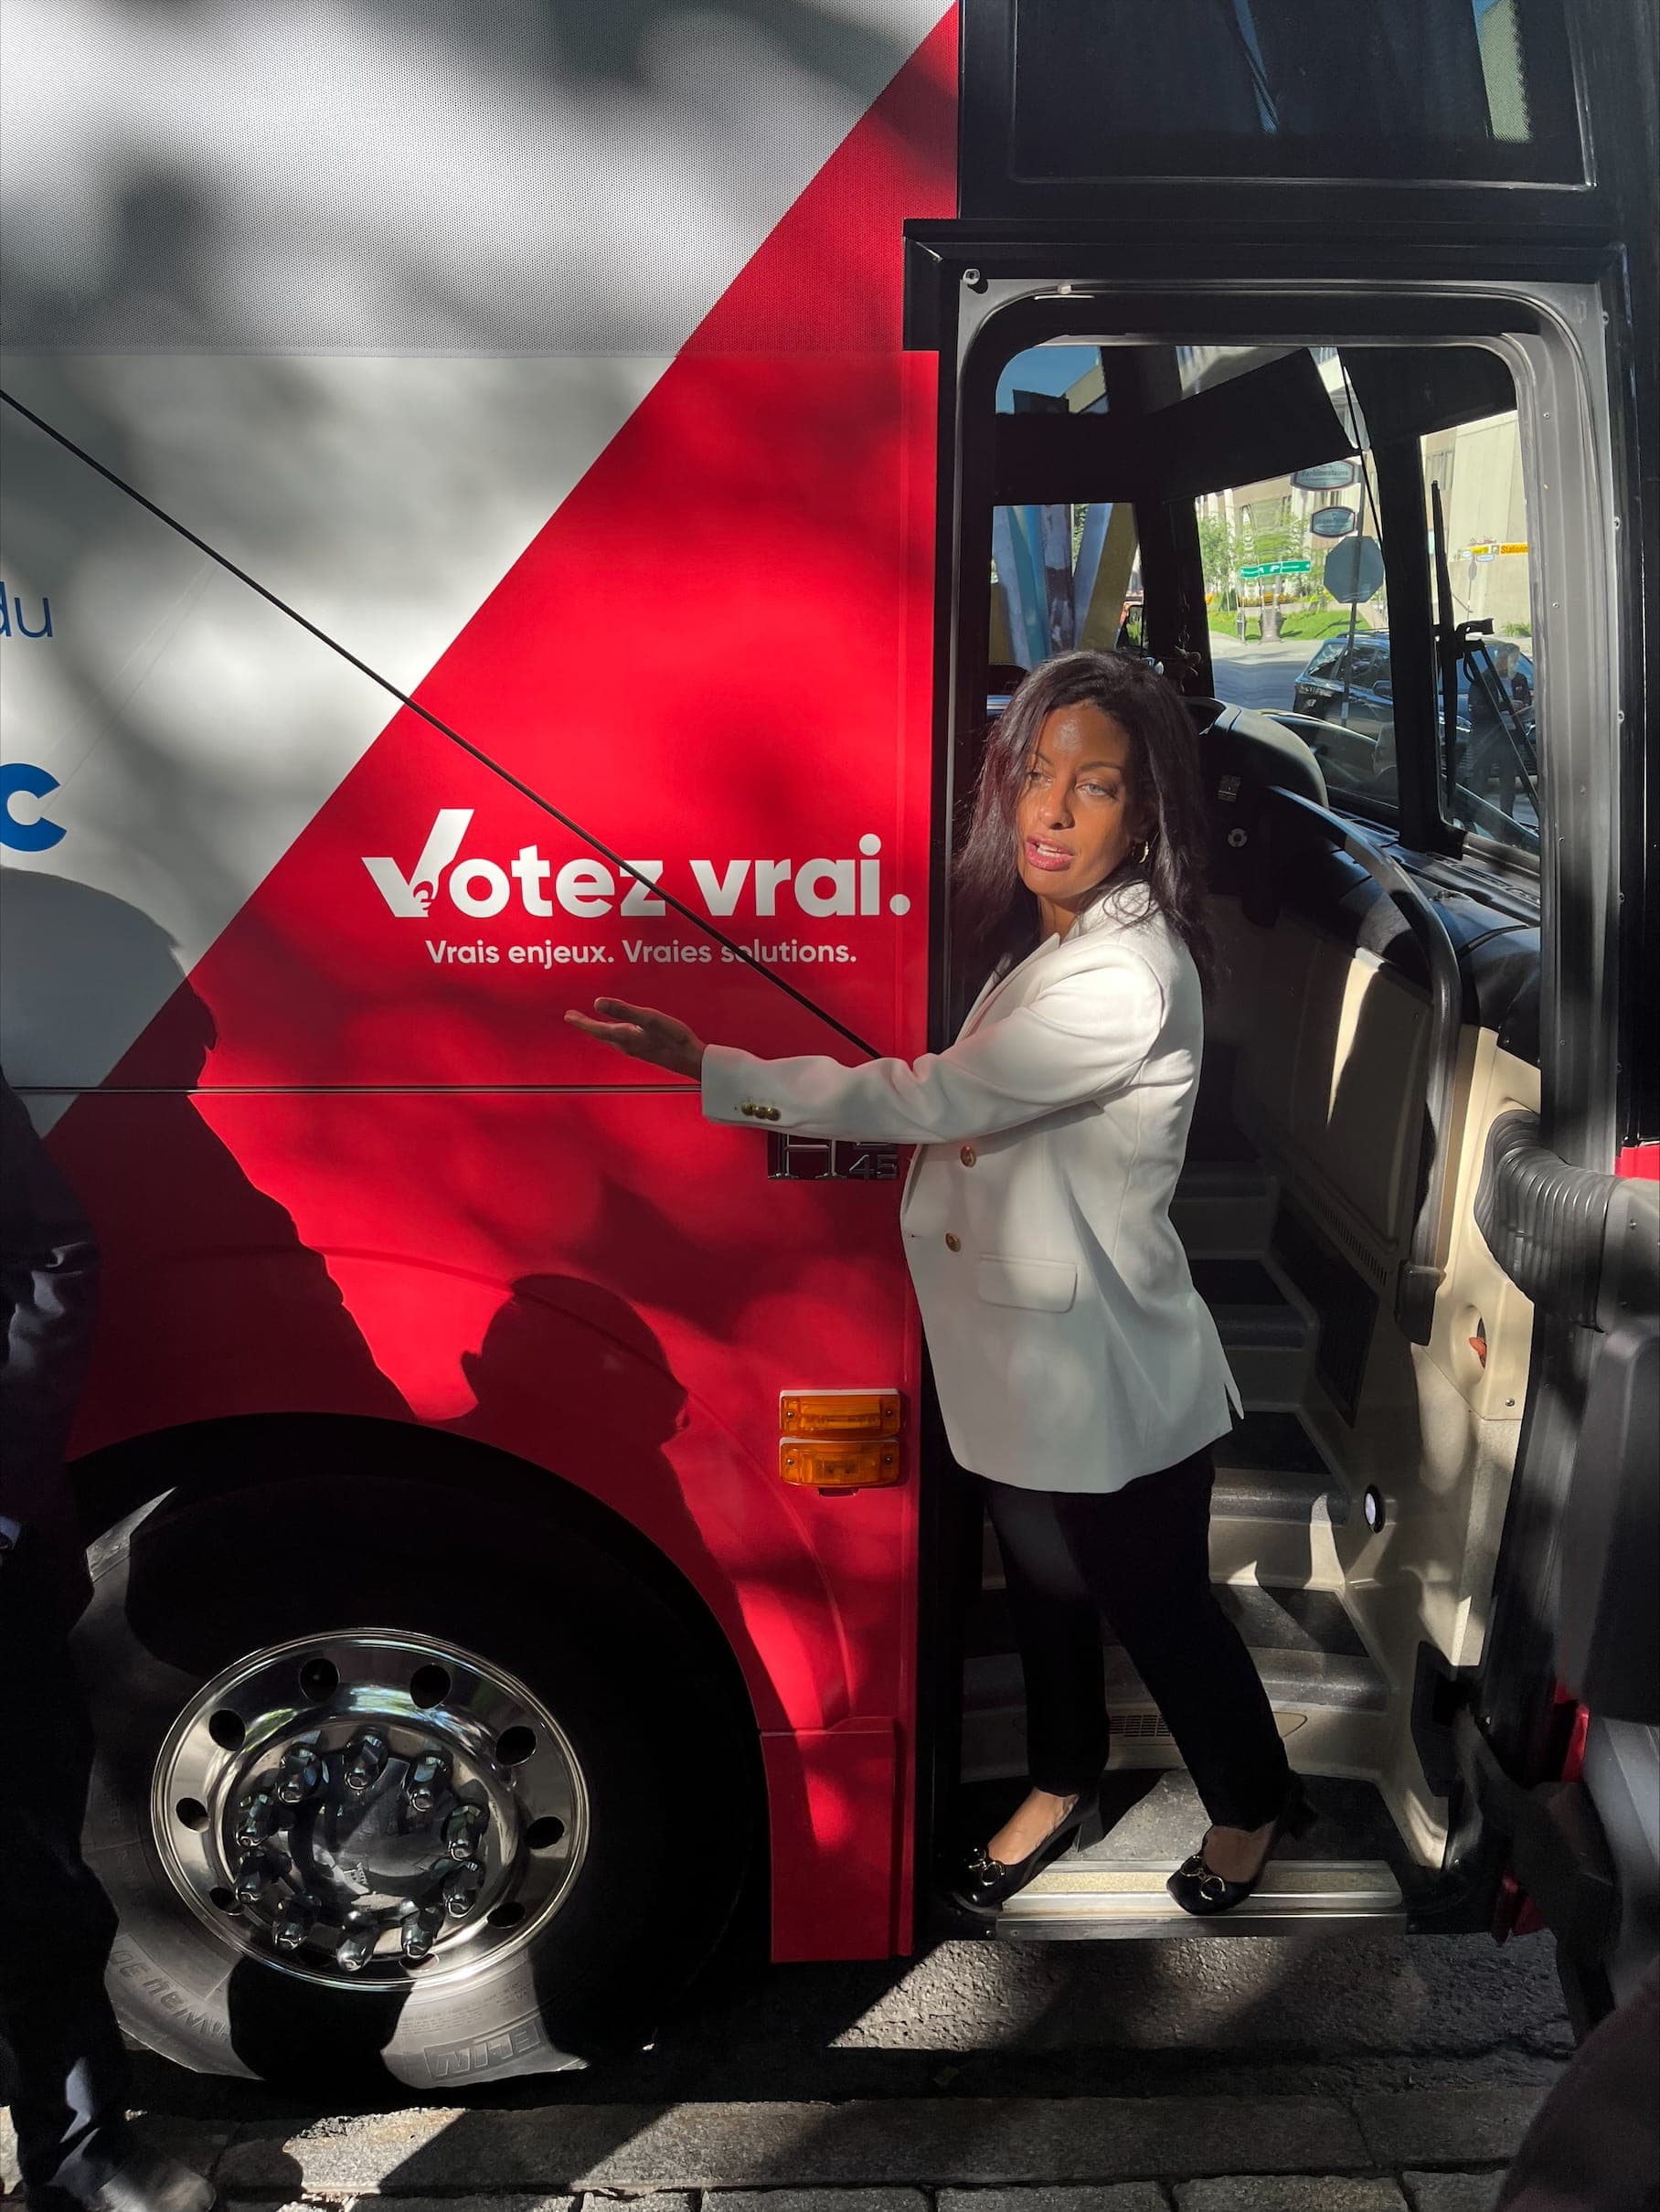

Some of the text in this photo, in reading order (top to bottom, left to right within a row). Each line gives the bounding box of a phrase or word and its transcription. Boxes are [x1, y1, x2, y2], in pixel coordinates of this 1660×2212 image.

[361, 808, 911, 919] Votez vrai.
[426, 940, 857, 970] Vrais enjeux. Vraies solutions.
